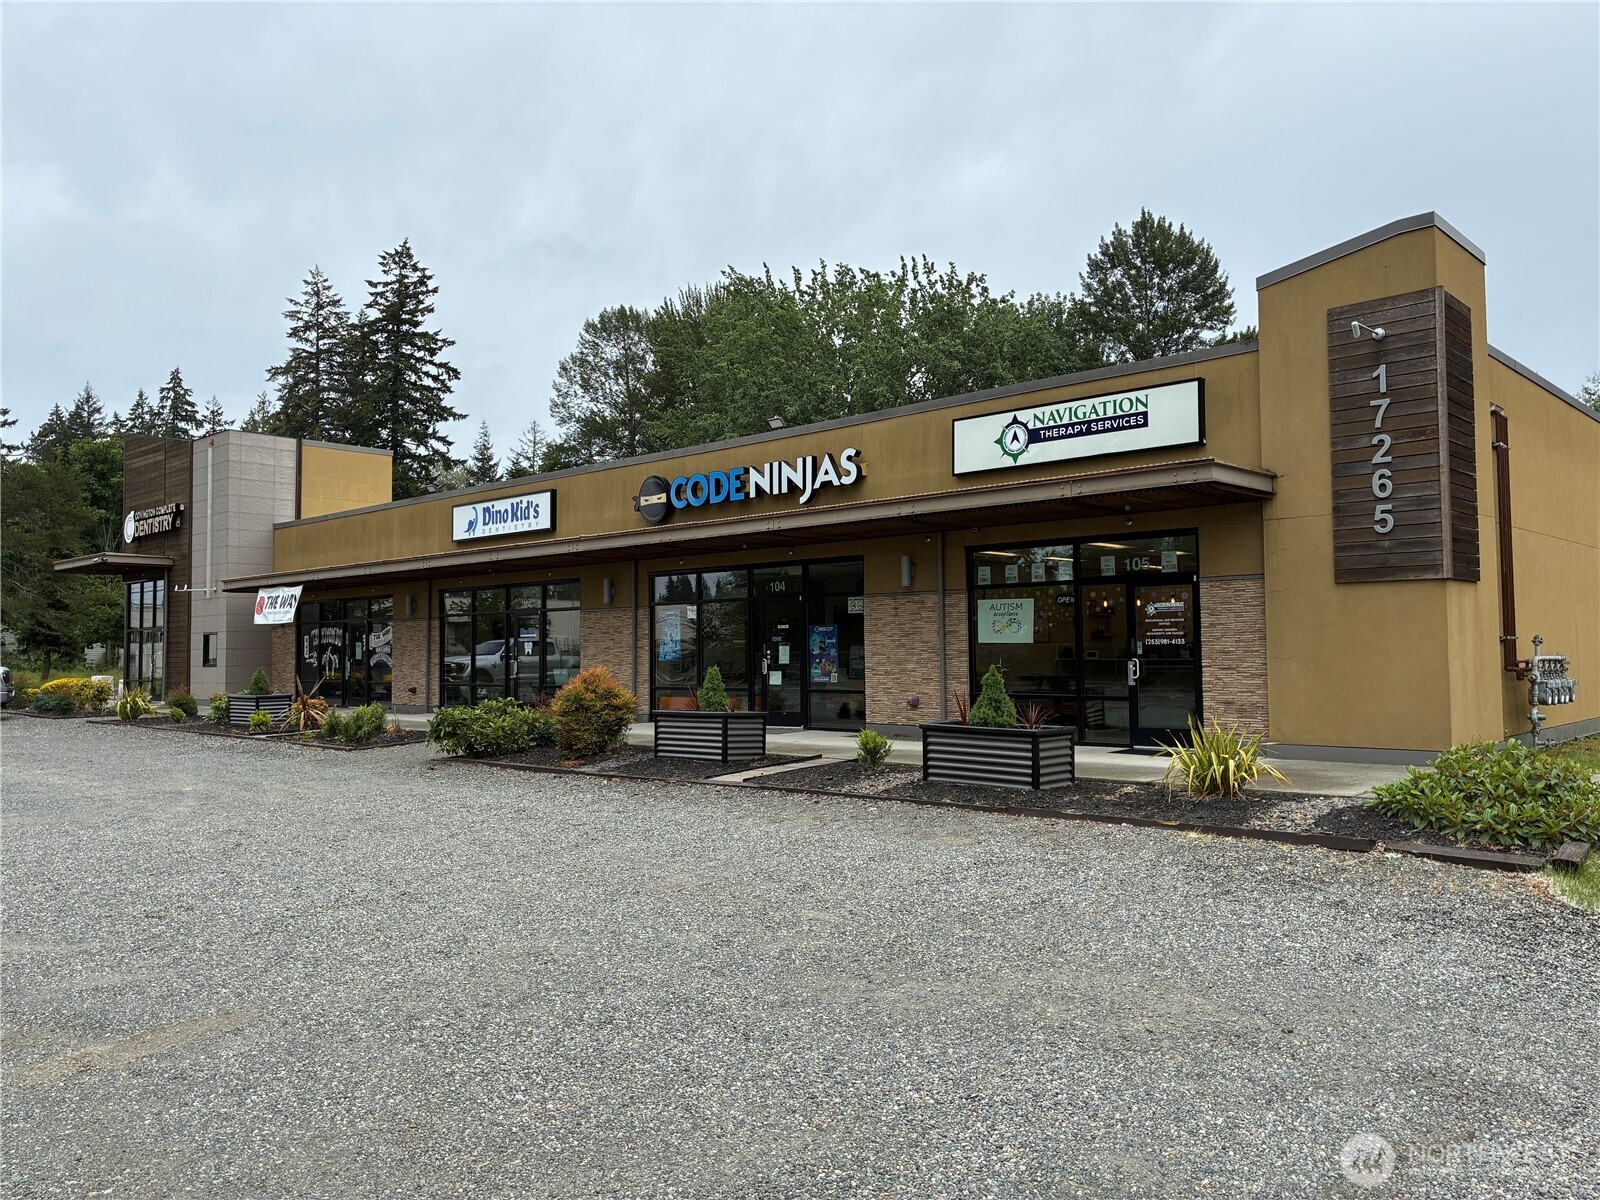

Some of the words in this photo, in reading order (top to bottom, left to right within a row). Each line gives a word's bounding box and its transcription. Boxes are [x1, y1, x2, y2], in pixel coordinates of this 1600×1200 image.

[1033, 394, 1150, 427] NAVIGATION
[1039, 423, 1088, 439] THERAPY
[1091, 415, 1145, 432] SERVICES
[1369, 364, 1394, 535] 17265
[670, 466, 745, 509] CODE
[749, 447, 858, 505] NINJAS
[156, 502, 176, 516] COMPLETE
[482, 504, 509, 527] Dino
[510, 499, 540, 523] Kid's
[134, 513, 174, 537] DENTISTRY
[482, 521, 540, 535] DENTISTRY
[1124, 556, 1150, 571] 105
[769, 581, 786, 592] 104
[264, 595, 280, 610] THE
[279, 593, 298, 609] WAY
[989, 603, 1023, 611] AUTISM
[993, 611, 1019, 619] acceptance
